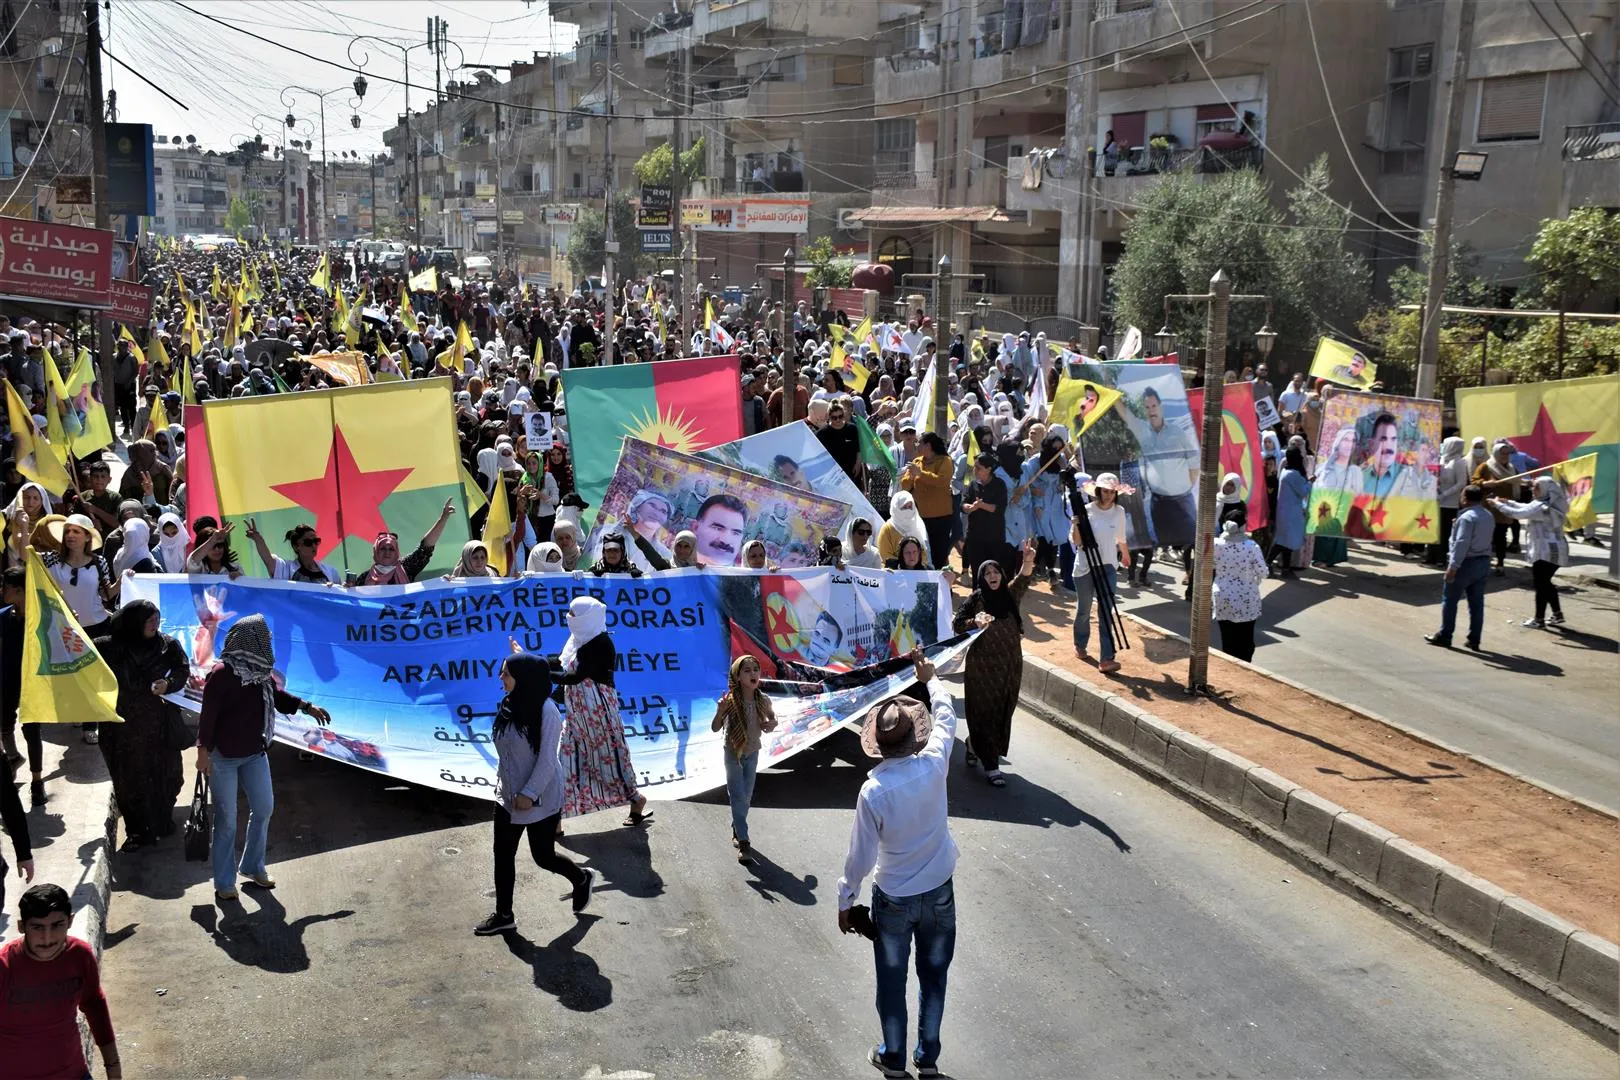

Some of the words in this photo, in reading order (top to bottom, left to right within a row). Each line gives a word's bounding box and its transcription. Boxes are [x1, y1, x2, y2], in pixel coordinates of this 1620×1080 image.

[9, 226, 99, 257] صيدلية
[643, 233, 671, 243] IELTS
[9, 258, 96, 287] يوسف
[378, 592, 505, 621] AZADIYA
[615, 586, 671, 606] APO
[346, 610, 529, 642] MISOGERIYA
[538, 601, 705, 629] DEOQRASÎ
[524, 627, 542, 651] Û
[382, 656, 506, 684] ARAMIY
